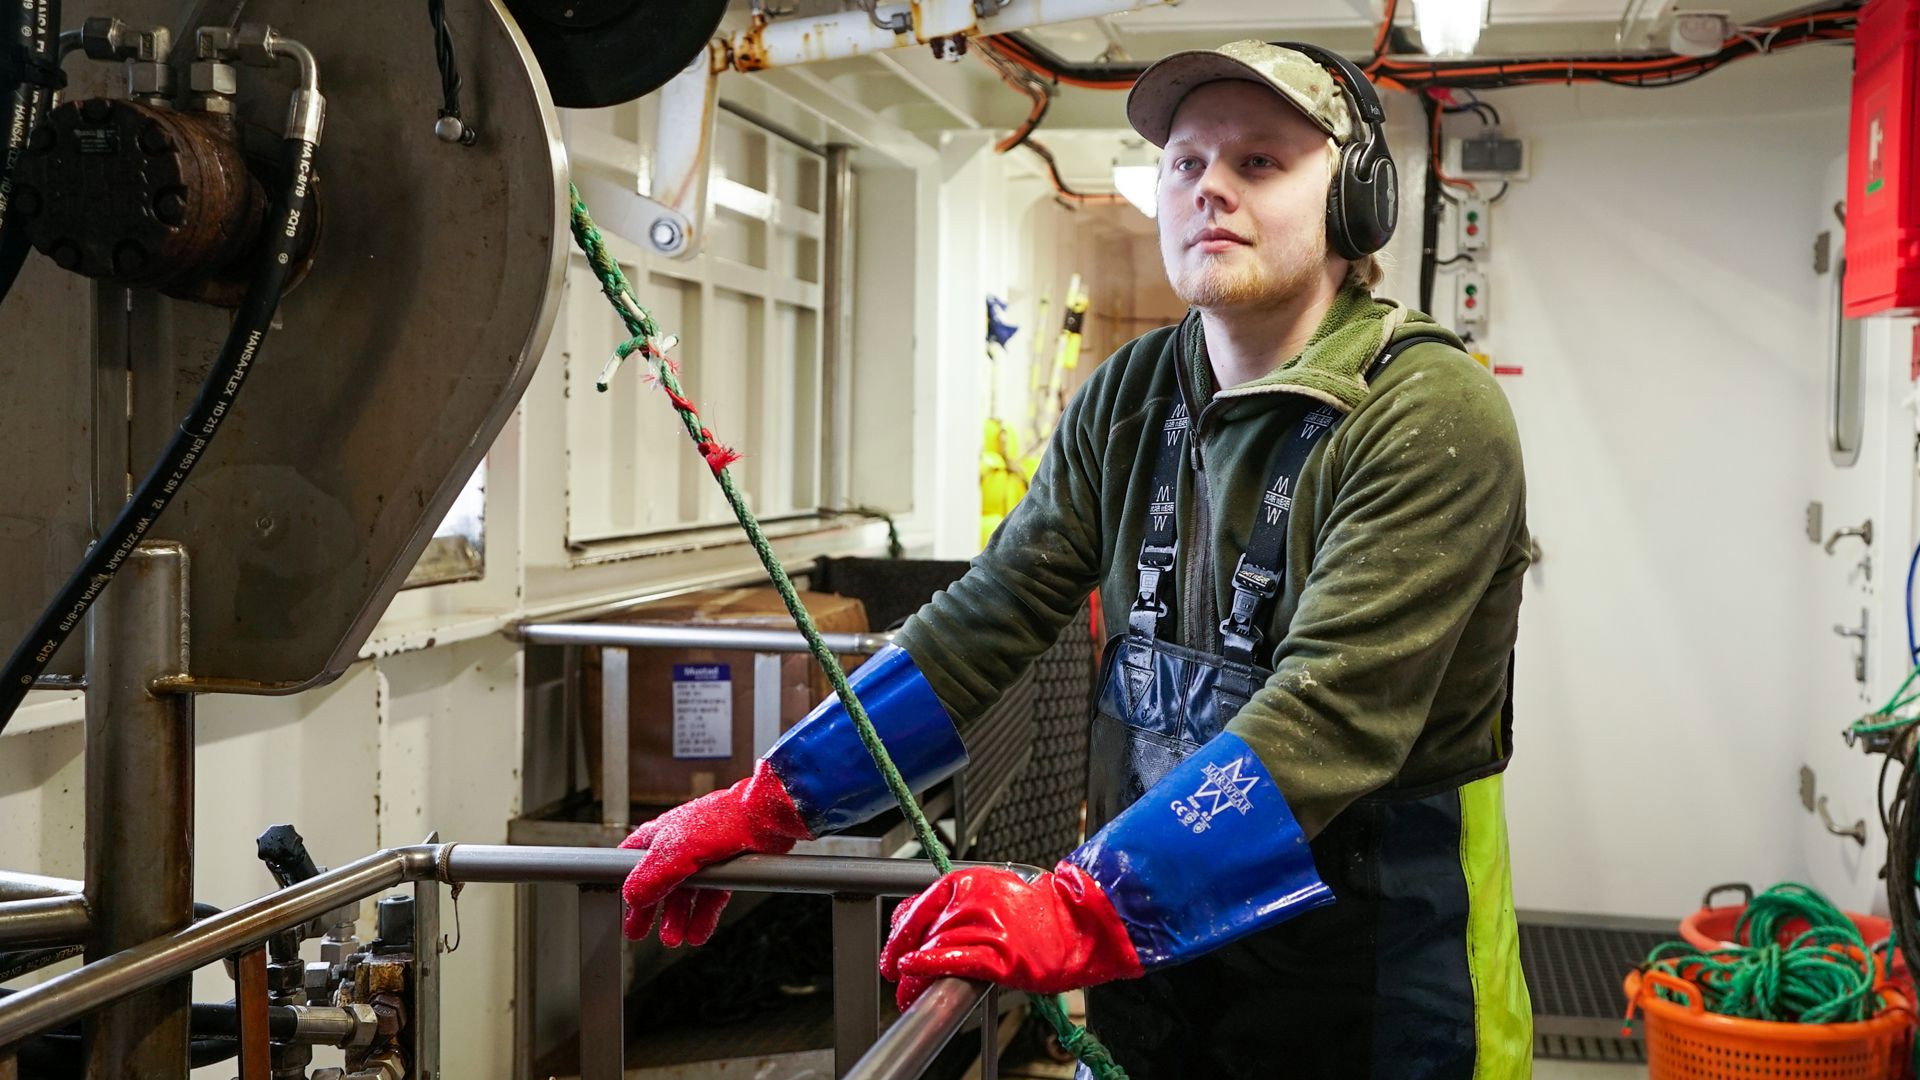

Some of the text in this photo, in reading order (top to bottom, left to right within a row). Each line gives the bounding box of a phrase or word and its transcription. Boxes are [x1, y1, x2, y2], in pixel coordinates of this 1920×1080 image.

[295, 159, 311, 198] IC-8/19
[285, 208, 300, 238] 2Q19
[223, 330, 262, 396] HANSA-FLEX
[212, 401, 228, 417] HD
[203, 416, 218, 433] 213
[190, 438, 206, 453] EN
[179, 453, 196, 470] 853
[163, 479, 178, 494] SN
[152, 498, 165, 509] 12
[136, 517, 152, 533] WP
[122, 533, 139, 549] 275
[105, 549, 127, 570] BAR
[59, 601, 88, 631] IC-8/19
[35, 639, 58, 663] 2Q19
